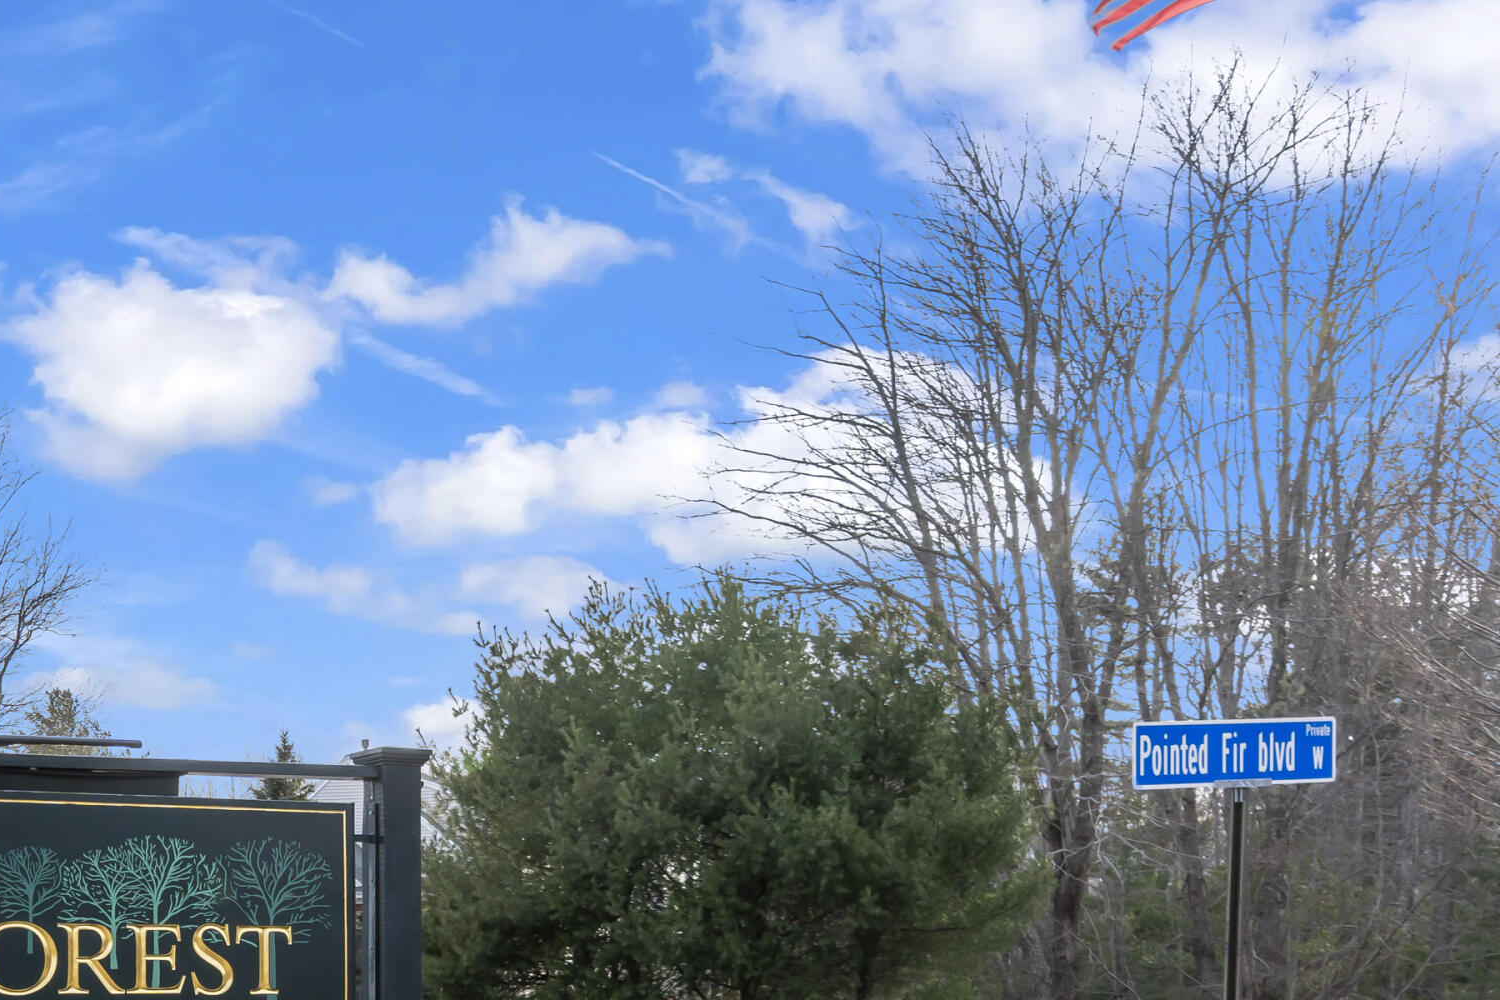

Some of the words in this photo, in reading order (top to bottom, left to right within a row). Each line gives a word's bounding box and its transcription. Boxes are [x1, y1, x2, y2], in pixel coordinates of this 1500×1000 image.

[1305, 723, 1331, 737] Private
[1139, 733, 1209, 776] Pointed
[1221, 731, 1247, 774] Fir
[1258, 730, 1296, 773] blvd
